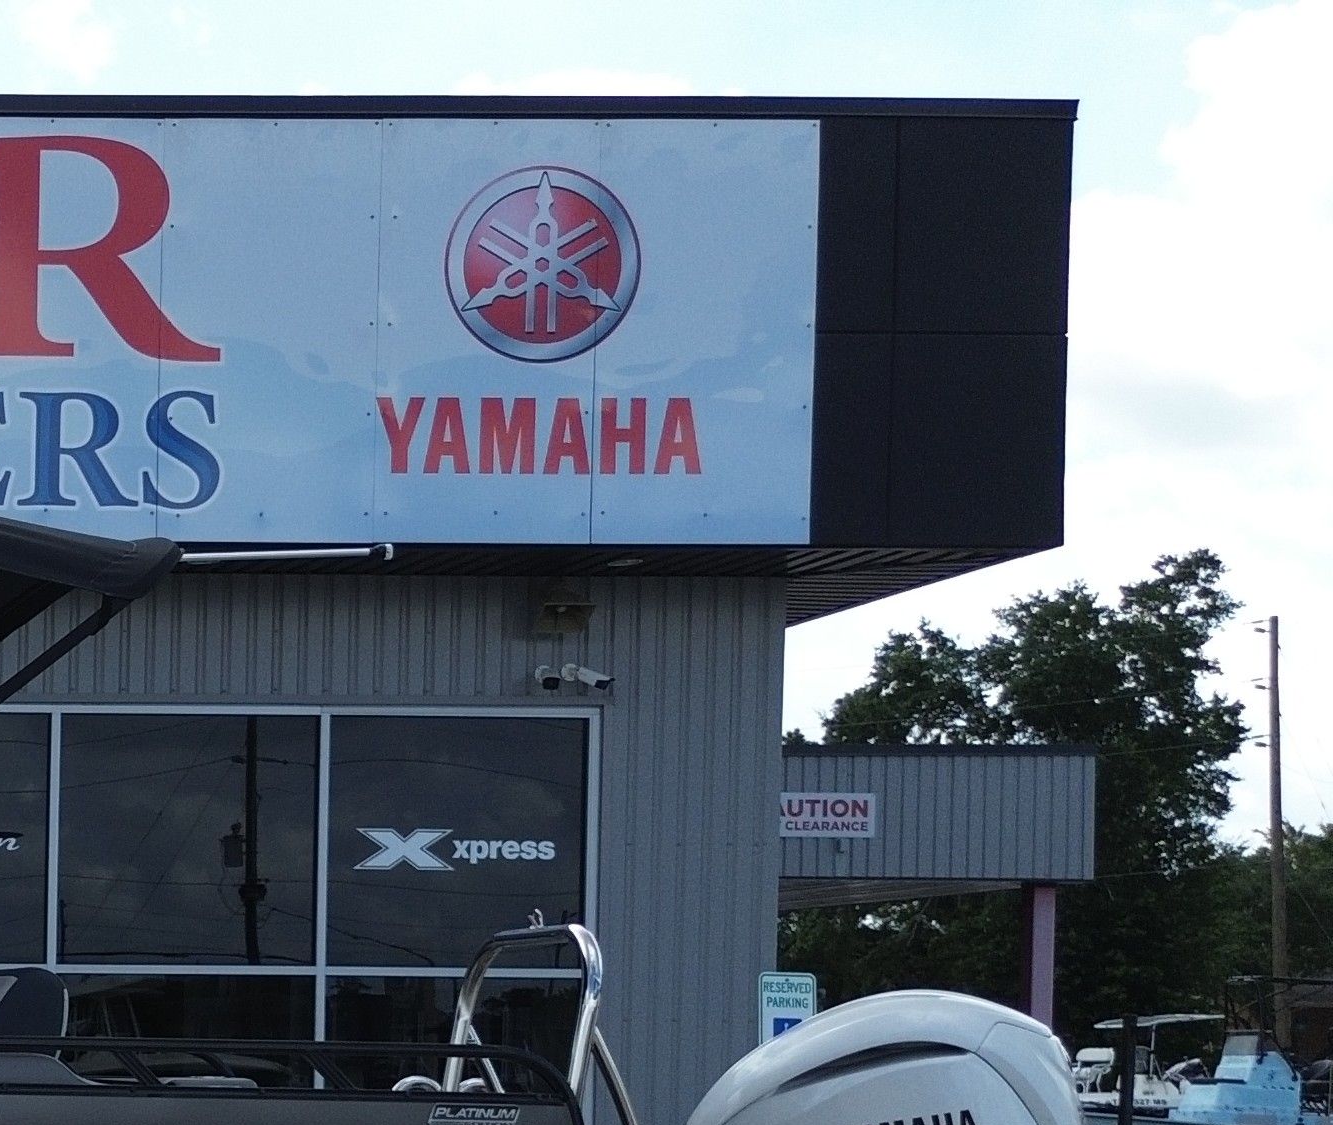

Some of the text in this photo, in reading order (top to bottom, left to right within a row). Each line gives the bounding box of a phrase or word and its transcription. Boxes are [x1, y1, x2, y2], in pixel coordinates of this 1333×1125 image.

[375, 396, 702, 475] YAMAHA
[785, 820, 870, 832] CLEARANCE
[452, 839, 556, 865] xpress
[763, 981, 812, 994] RESERVED
[766, 996, 809, 1009] PARKING
[434, 1107, 517, 1119] PLATINUM
